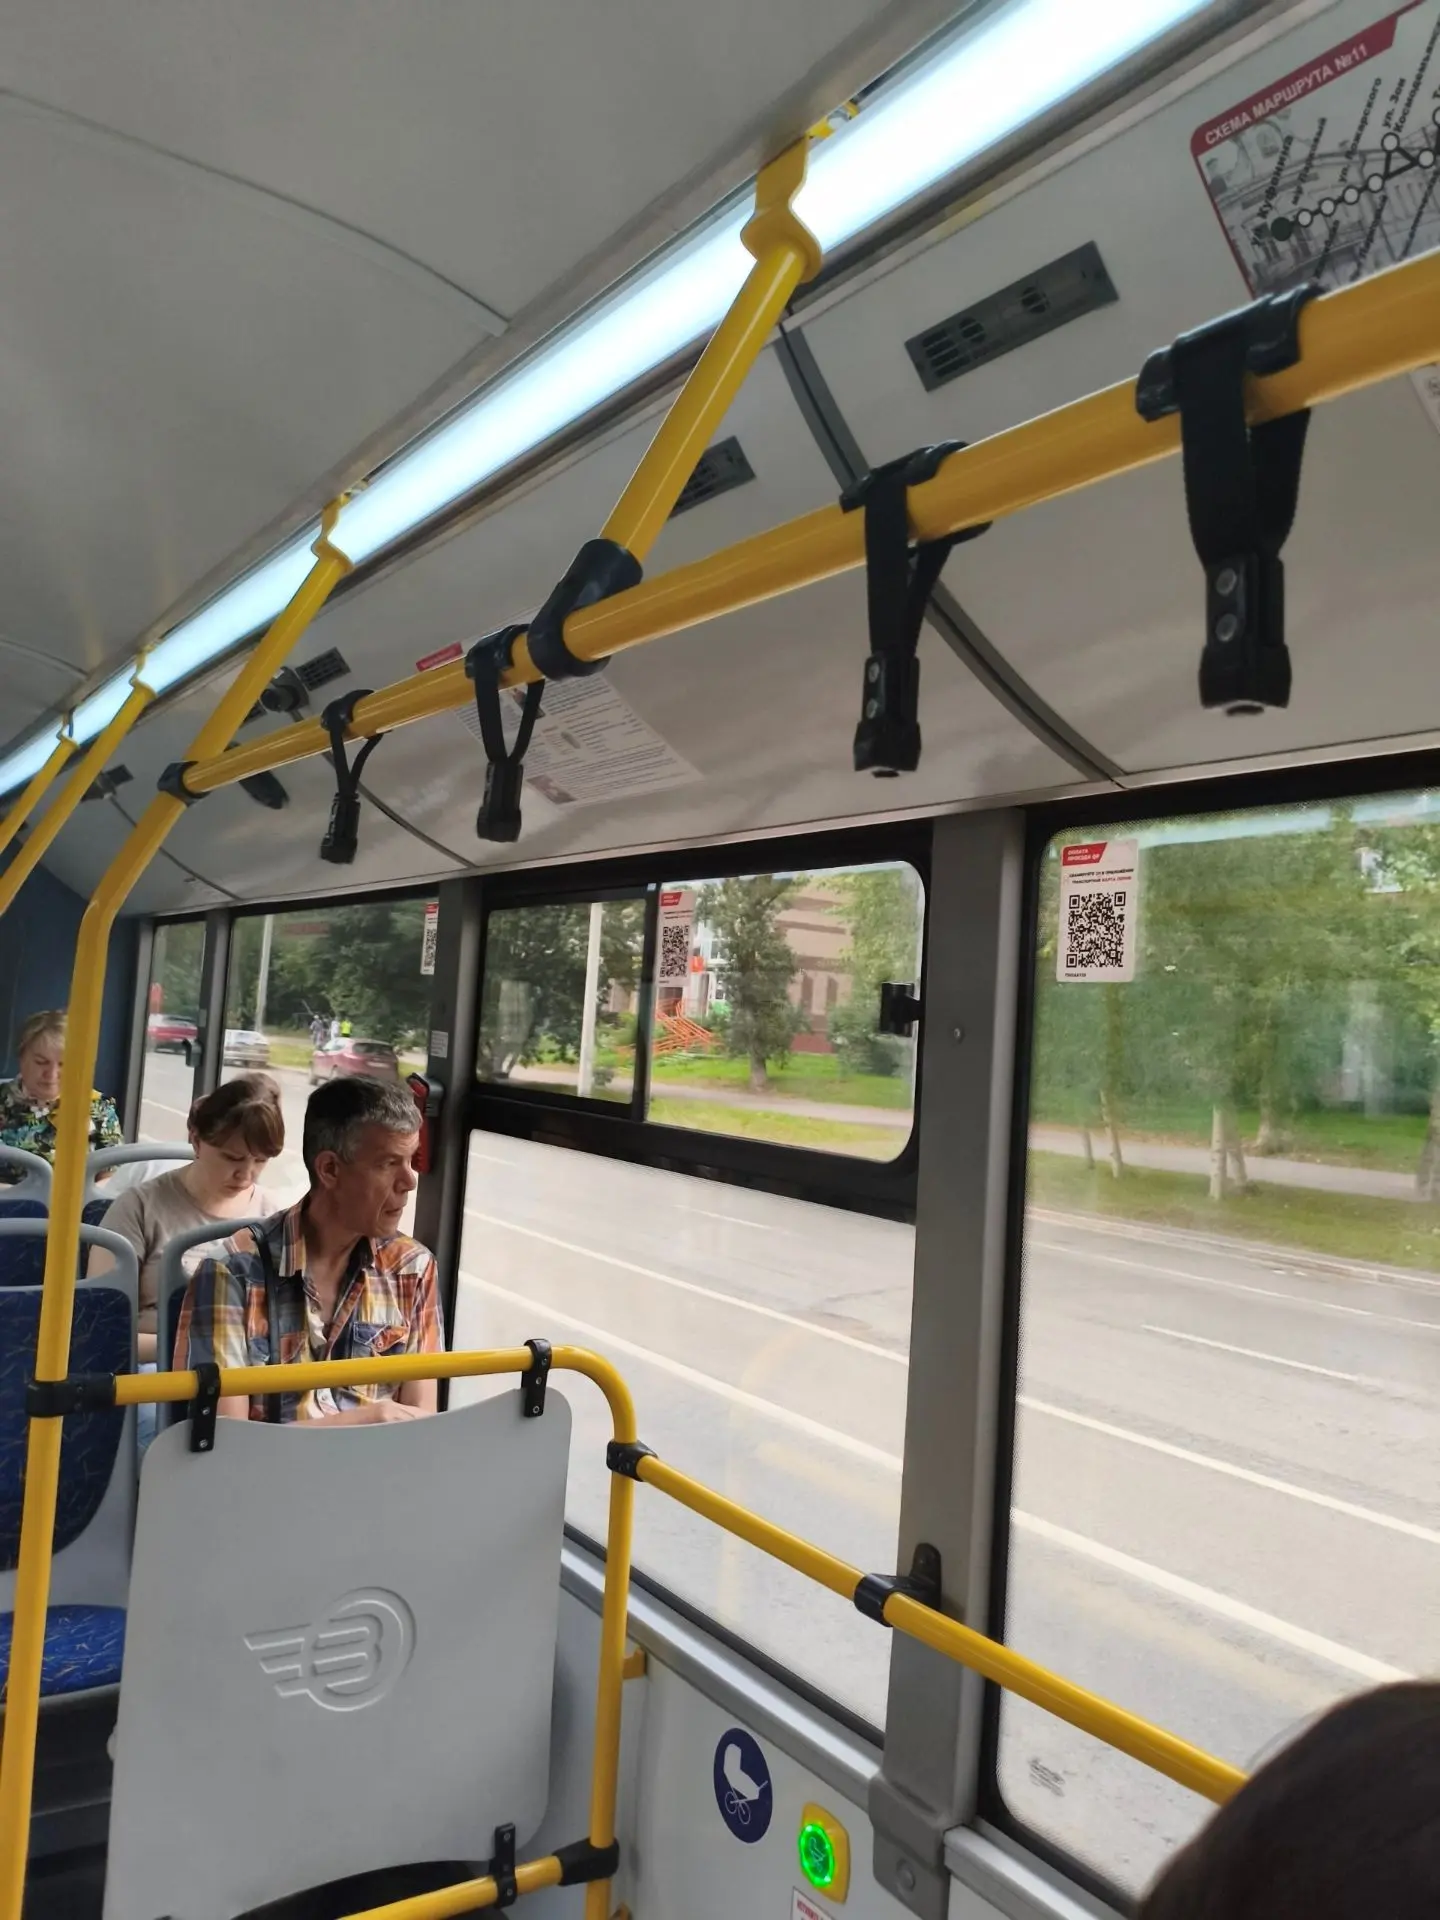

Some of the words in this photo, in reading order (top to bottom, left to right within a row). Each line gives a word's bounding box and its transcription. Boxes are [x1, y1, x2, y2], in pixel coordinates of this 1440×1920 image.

[1205, 112, 1252, 144] СХЕМА
[1252, 65, 1333, 118] МАРШРУТА
[1334, 43, 1368, 71] №11
[1346, 77, 1382, 160] Пожарского
[1382, 107, 1395, 129] ул.
